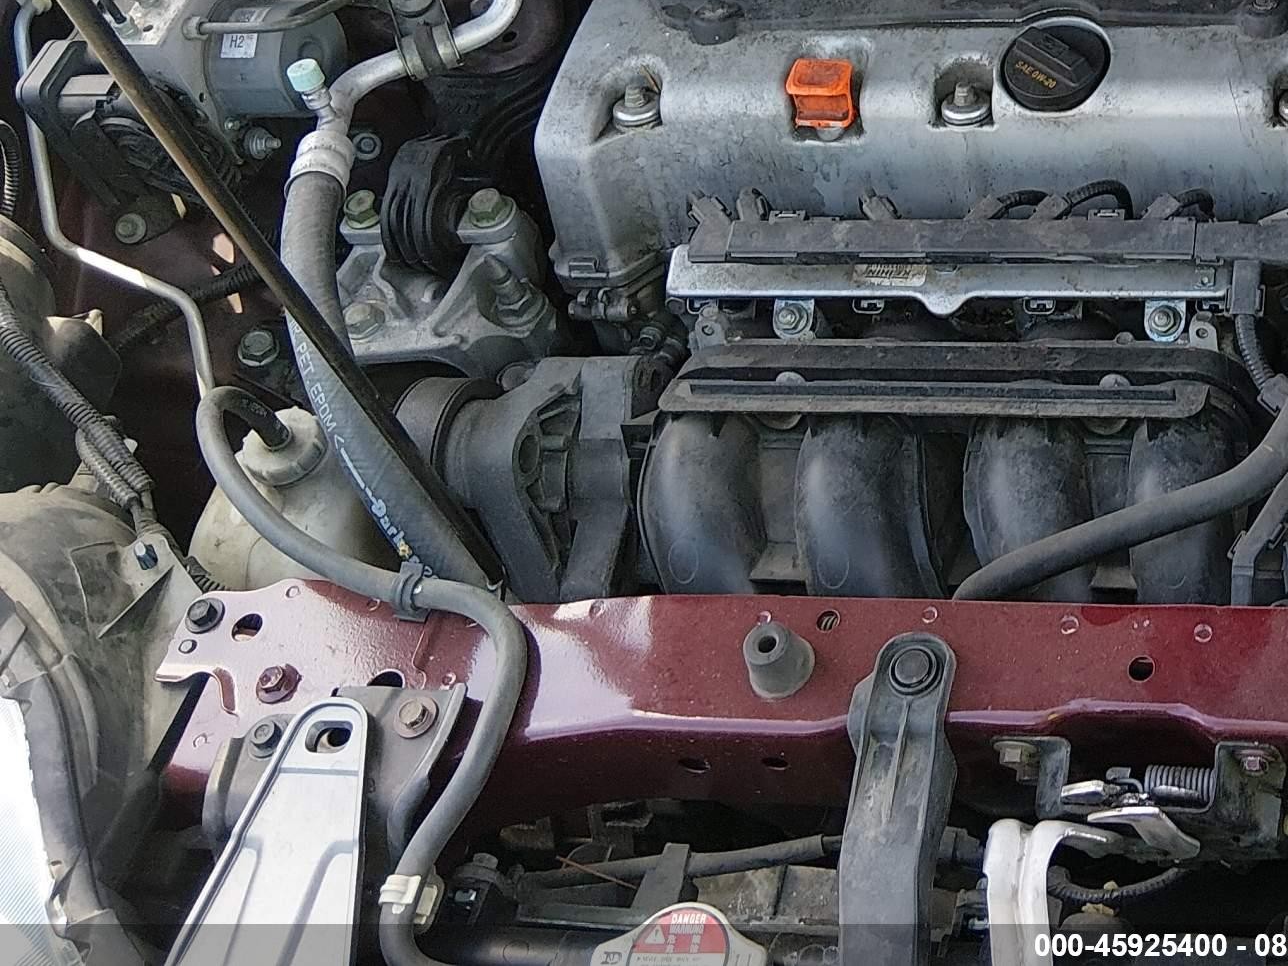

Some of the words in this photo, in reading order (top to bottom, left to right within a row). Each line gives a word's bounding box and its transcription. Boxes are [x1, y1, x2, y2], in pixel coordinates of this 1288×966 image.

[229, 34, 245, 48] H2
[1015, 60, 1034, 74] SAE
[1031, 70, 1057, 89] 0W-20
[310, 382, 337, 432] EPDM
[671, 914, 707, 924] DANGER
